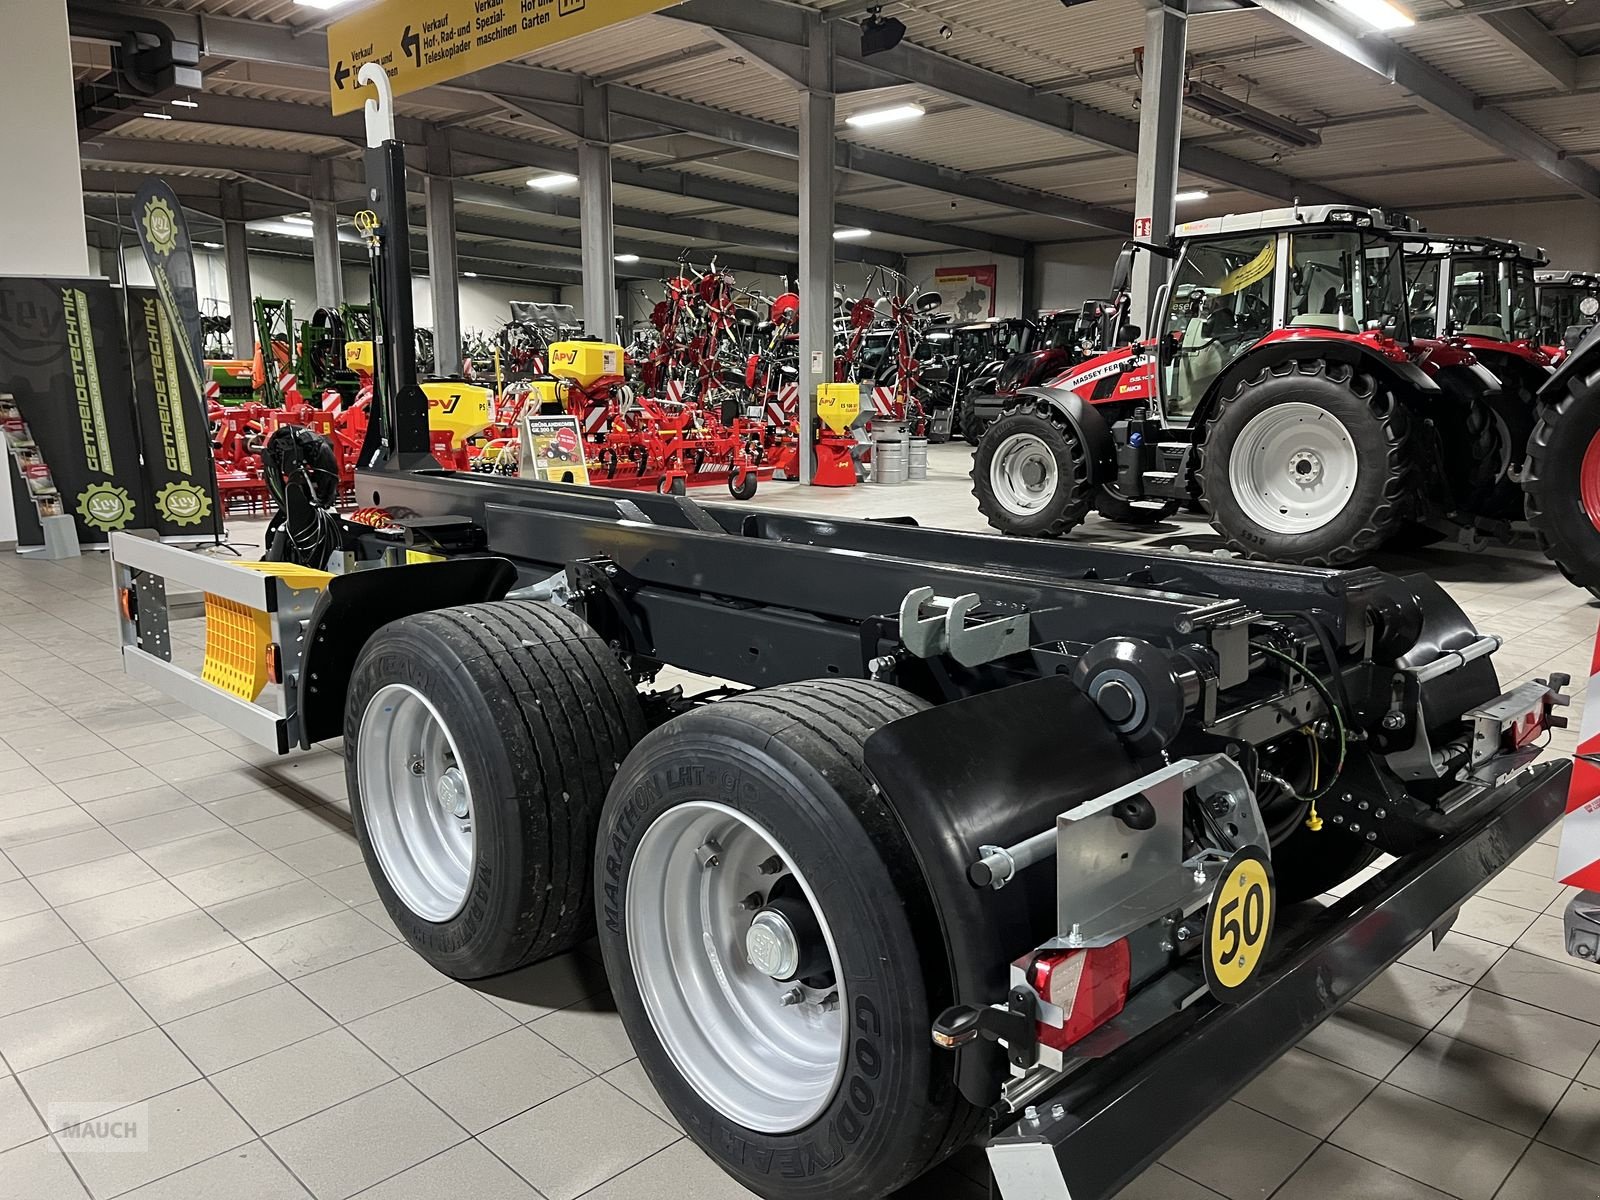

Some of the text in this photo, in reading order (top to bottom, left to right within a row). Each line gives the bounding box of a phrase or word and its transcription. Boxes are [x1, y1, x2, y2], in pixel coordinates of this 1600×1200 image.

[422, 13, 448, 34] Verkauf
[457, 21, 470, 37] und
[476, 9, 505, 31] Spezial-
[521, 12, 550, 30] Garten
[476, 24, 517, 46] maschinen
[351, 43, 373, 61] Verkauf
[380, 51, 392, 65] und
[424, 39, 471, 64] Teleskoplader
[1172, 302, 1193, 310] esel
[61, 287, 99, 471] GETREIDETECHNIK
[142, 297, 178, 471] GETREIDETECHNIK
[1073, 370, 1102, 386] MASSEY
[603, 778, 661, 935] MARATHON
[1219, 883, 1264, 965] 50
[720, 994, 881, 1178] GOODYEAR
